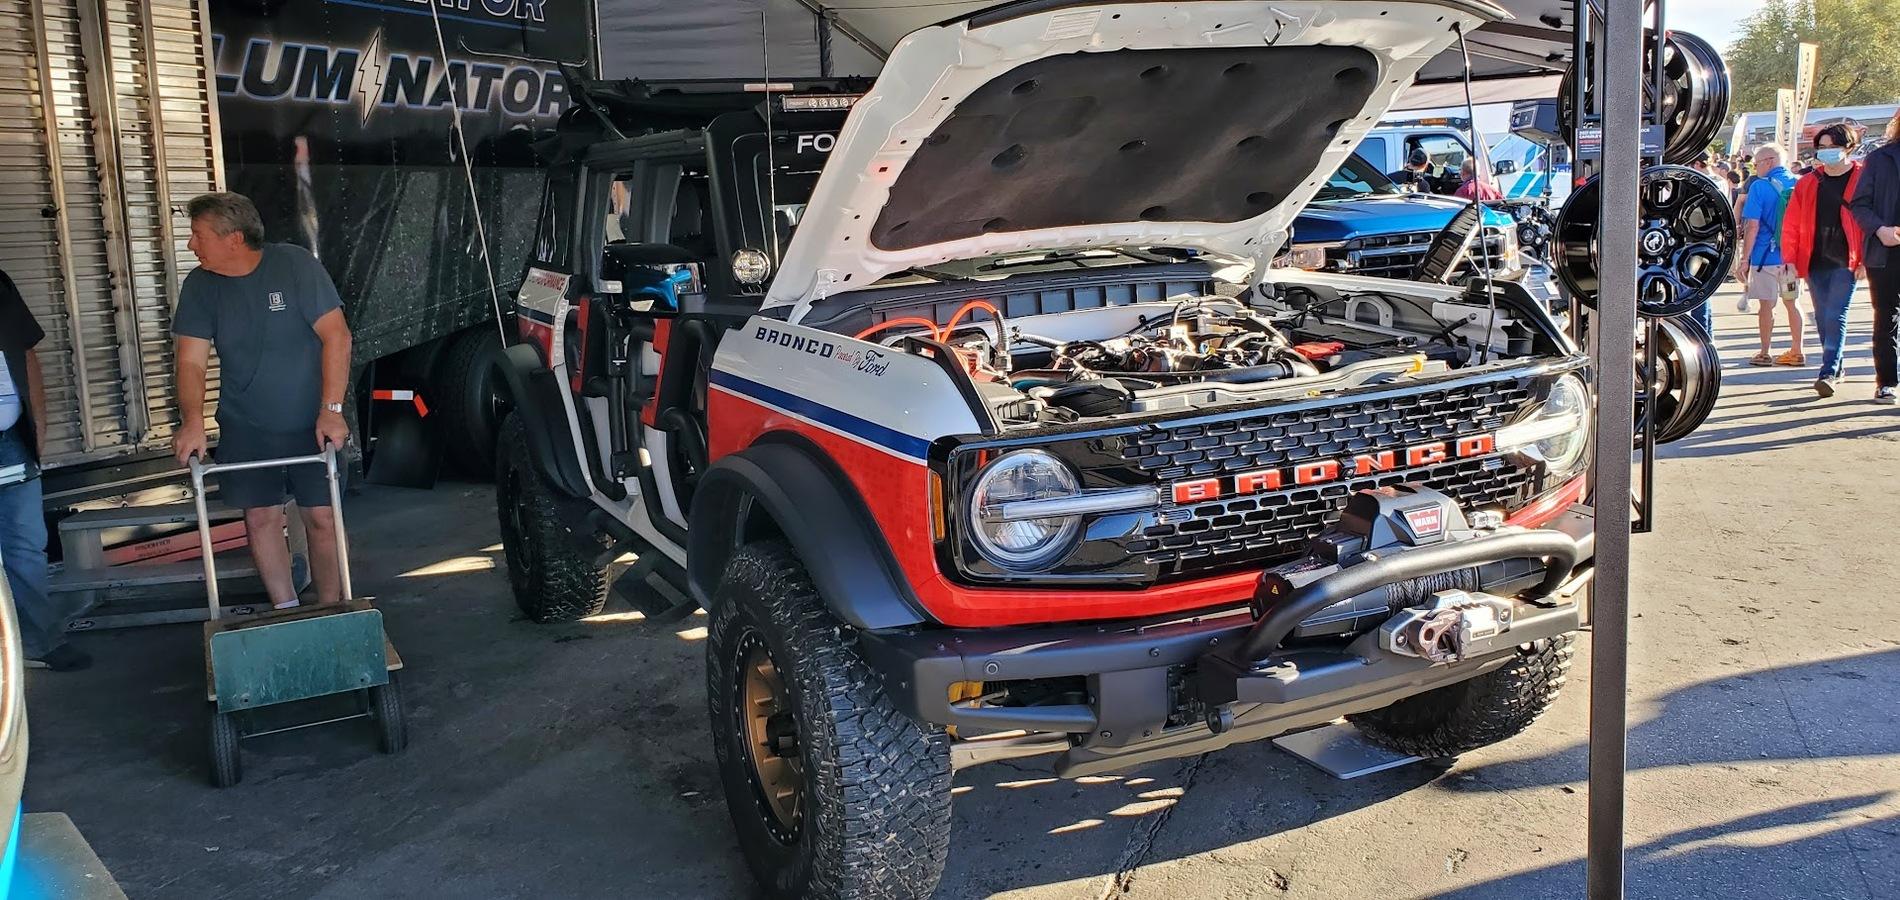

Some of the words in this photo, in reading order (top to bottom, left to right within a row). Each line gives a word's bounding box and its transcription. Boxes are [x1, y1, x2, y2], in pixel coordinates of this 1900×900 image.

[755, 326, 834, 358] BRONCO
[858, 350, 890, 377] Ford
[1172, 432, 1494, 504] BRONCO
[1414, 514, 1437, 529] WARN
